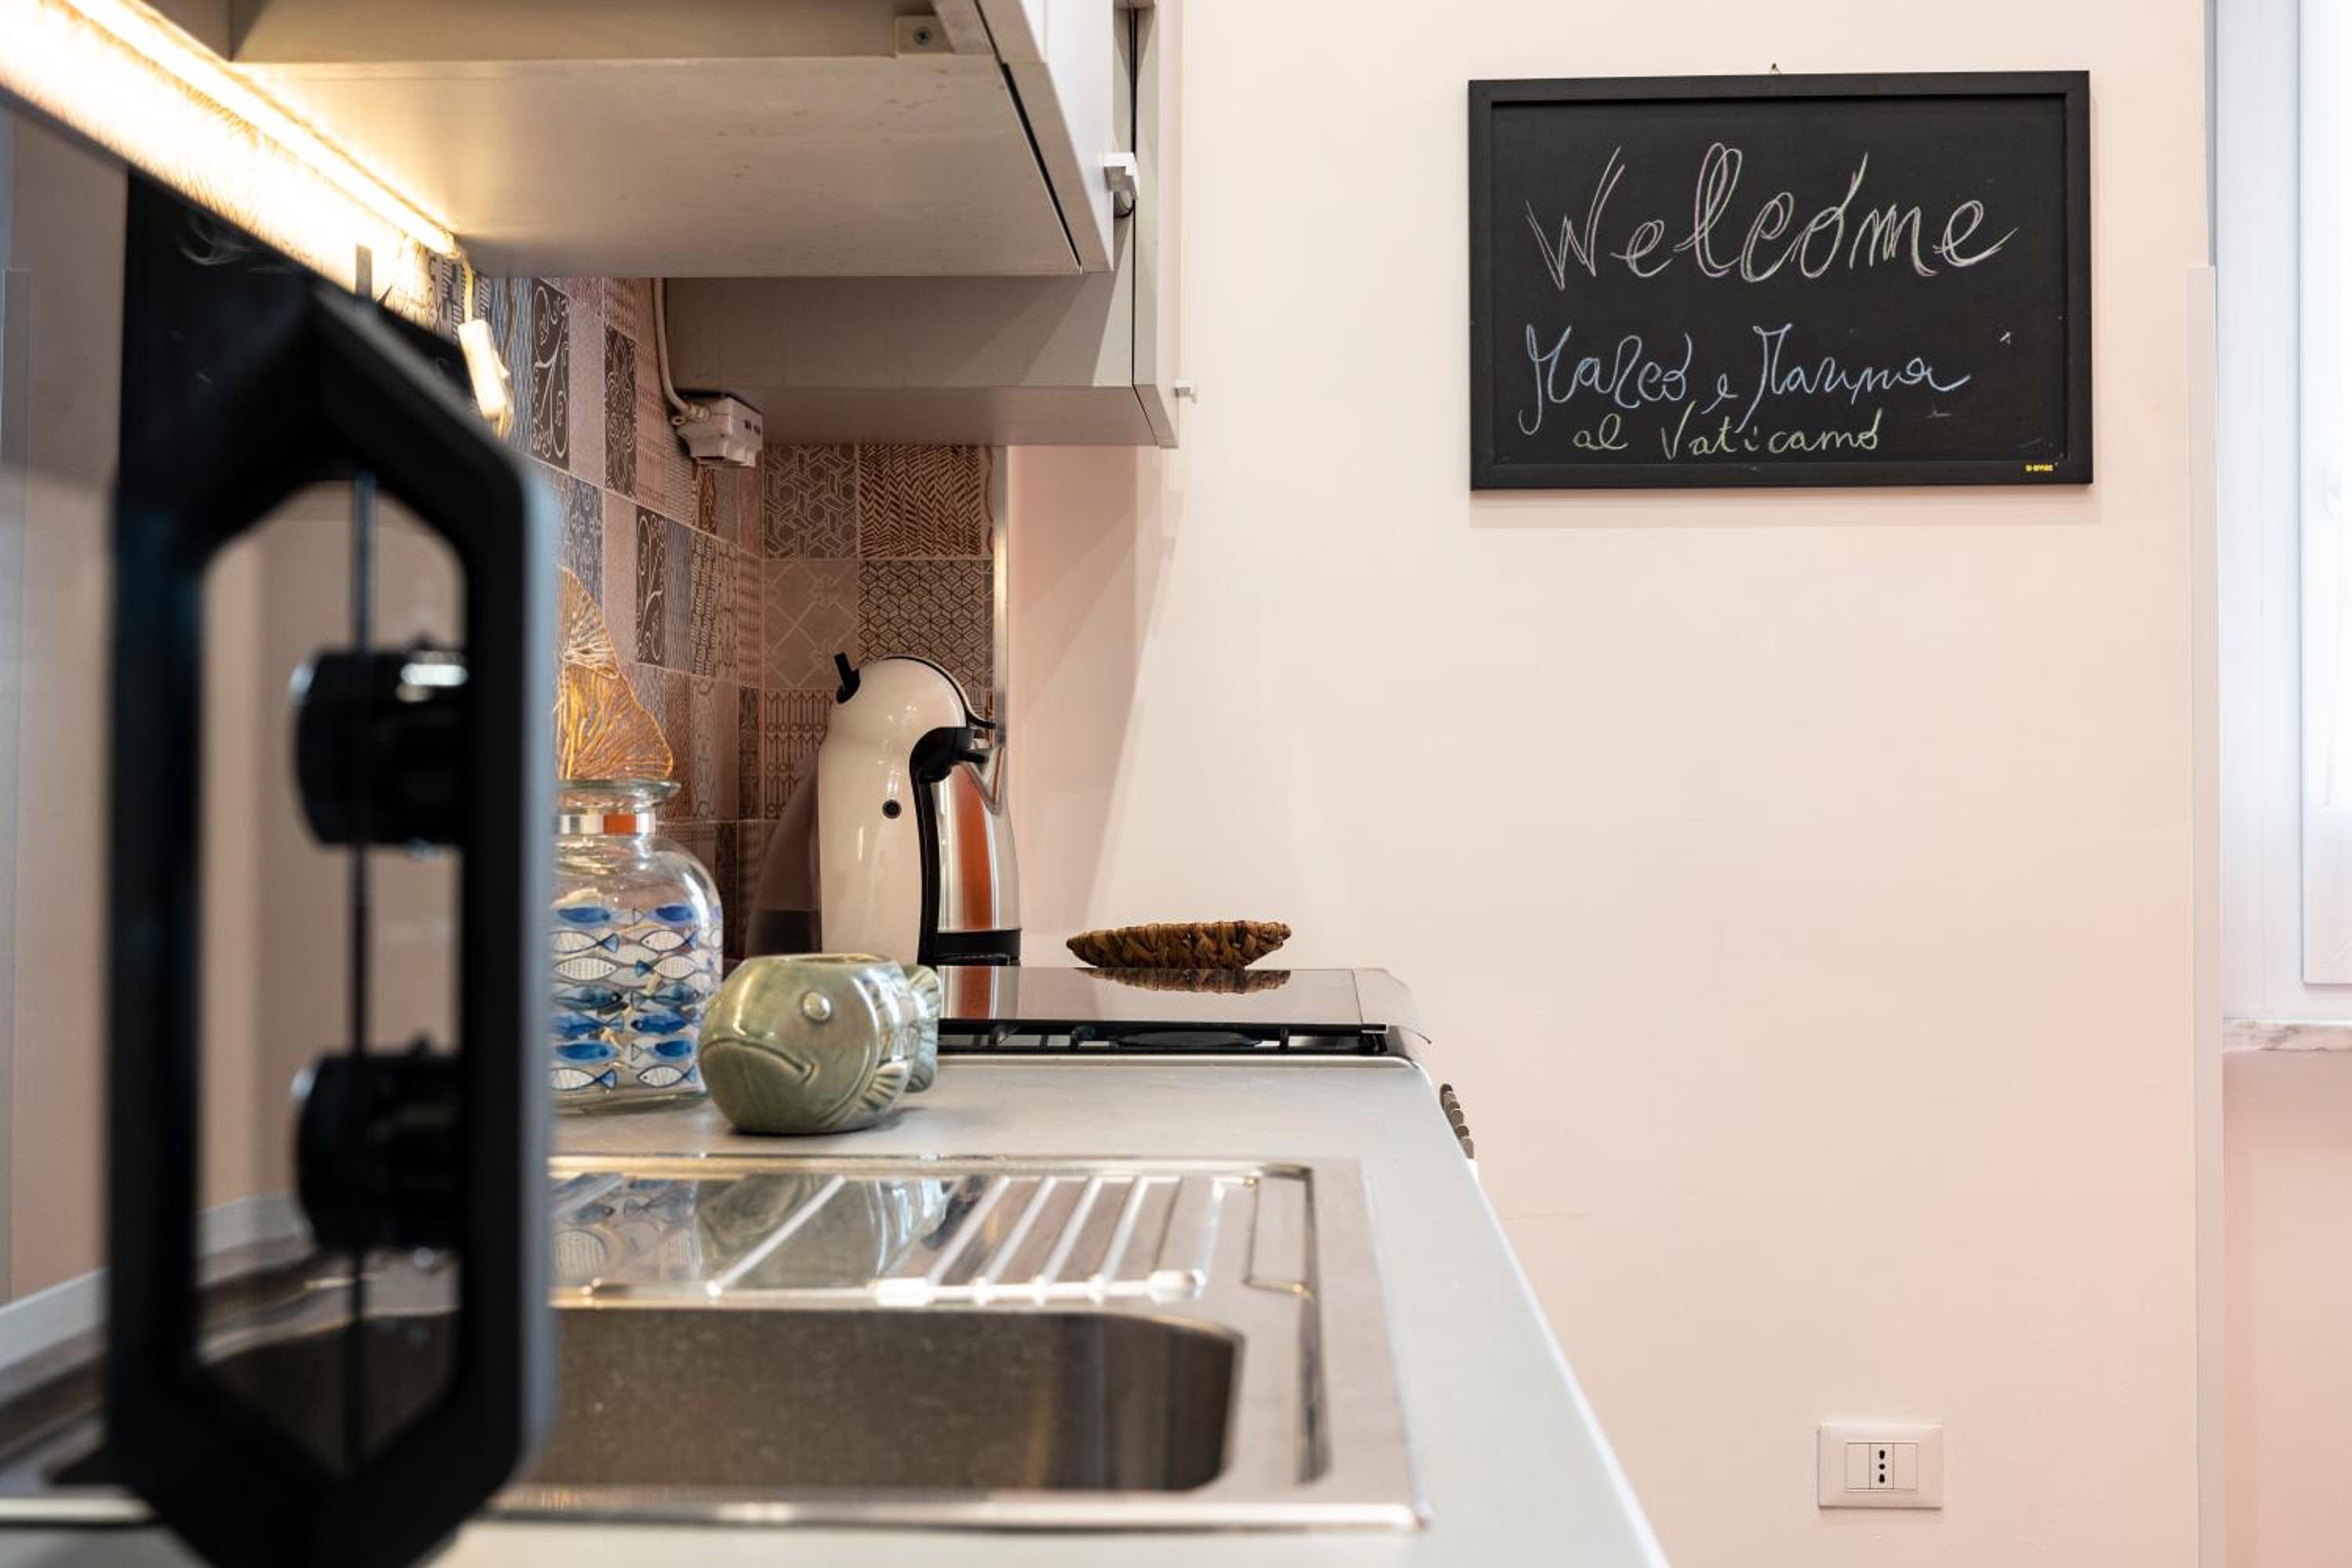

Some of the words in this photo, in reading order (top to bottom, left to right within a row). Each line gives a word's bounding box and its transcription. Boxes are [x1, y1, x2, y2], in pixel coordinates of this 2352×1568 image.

[1525, 141, 2019, 291] Welcome
[1518, 323, 1693, 435] Marco
[1700, 372, 1739, 416] e
[1572, 413, 1629, 451] al
